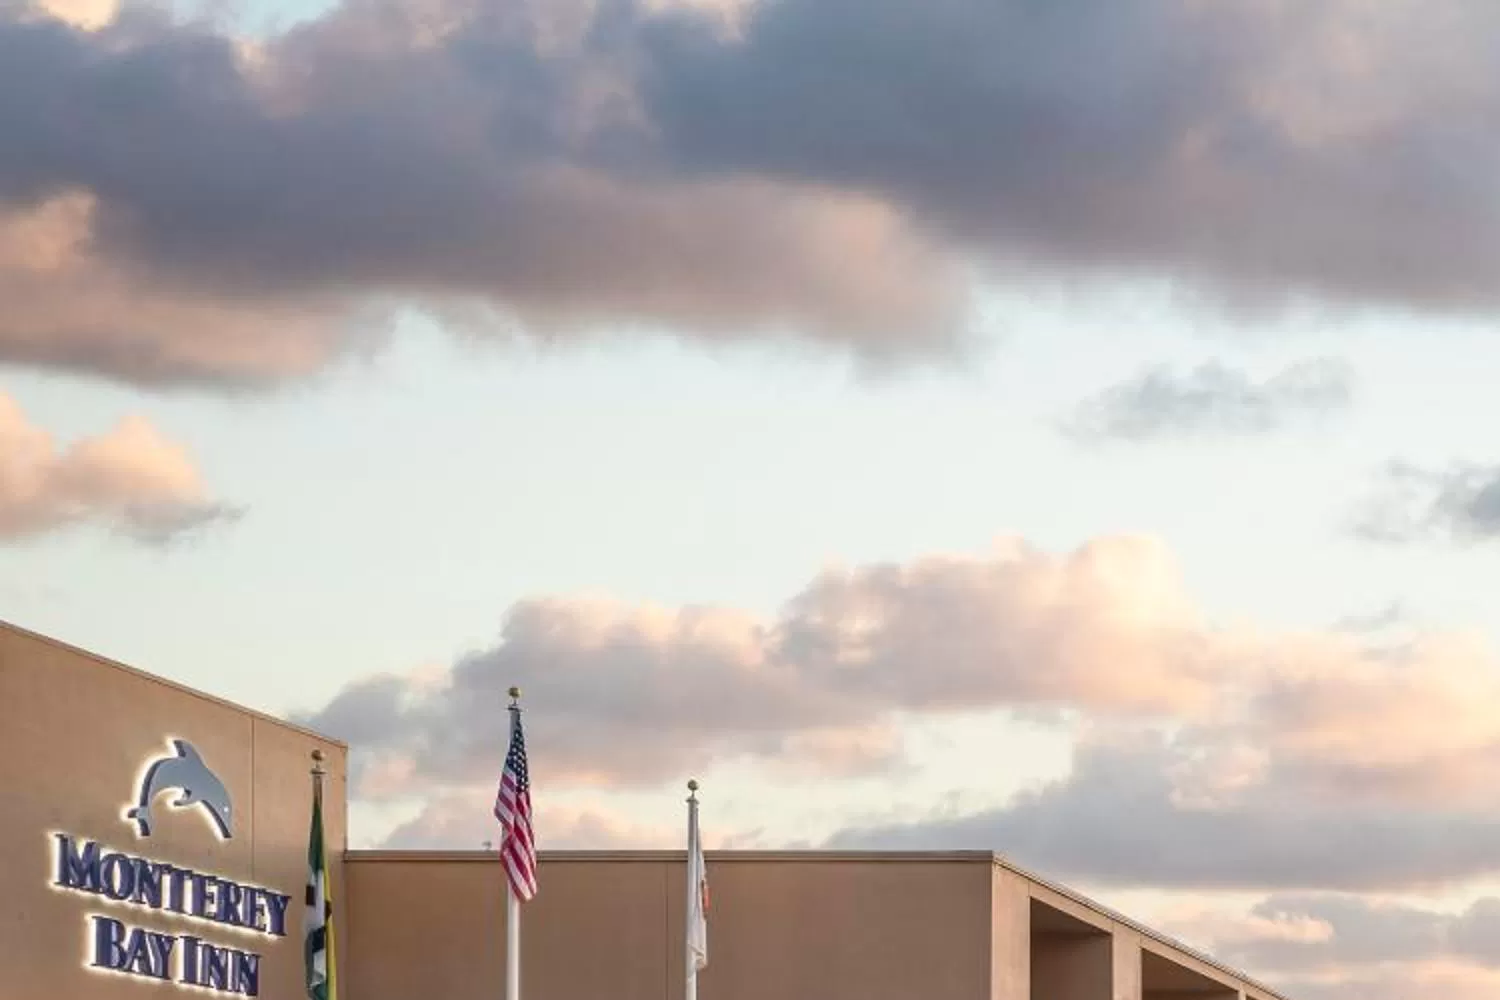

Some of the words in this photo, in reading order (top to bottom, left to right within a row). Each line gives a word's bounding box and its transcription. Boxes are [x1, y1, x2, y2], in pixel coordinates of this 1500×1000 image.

[53, 832, 292, 937] MONTEREY
[89, 914, 175, 981] BAY
[177, 934, 262, 998] INN
